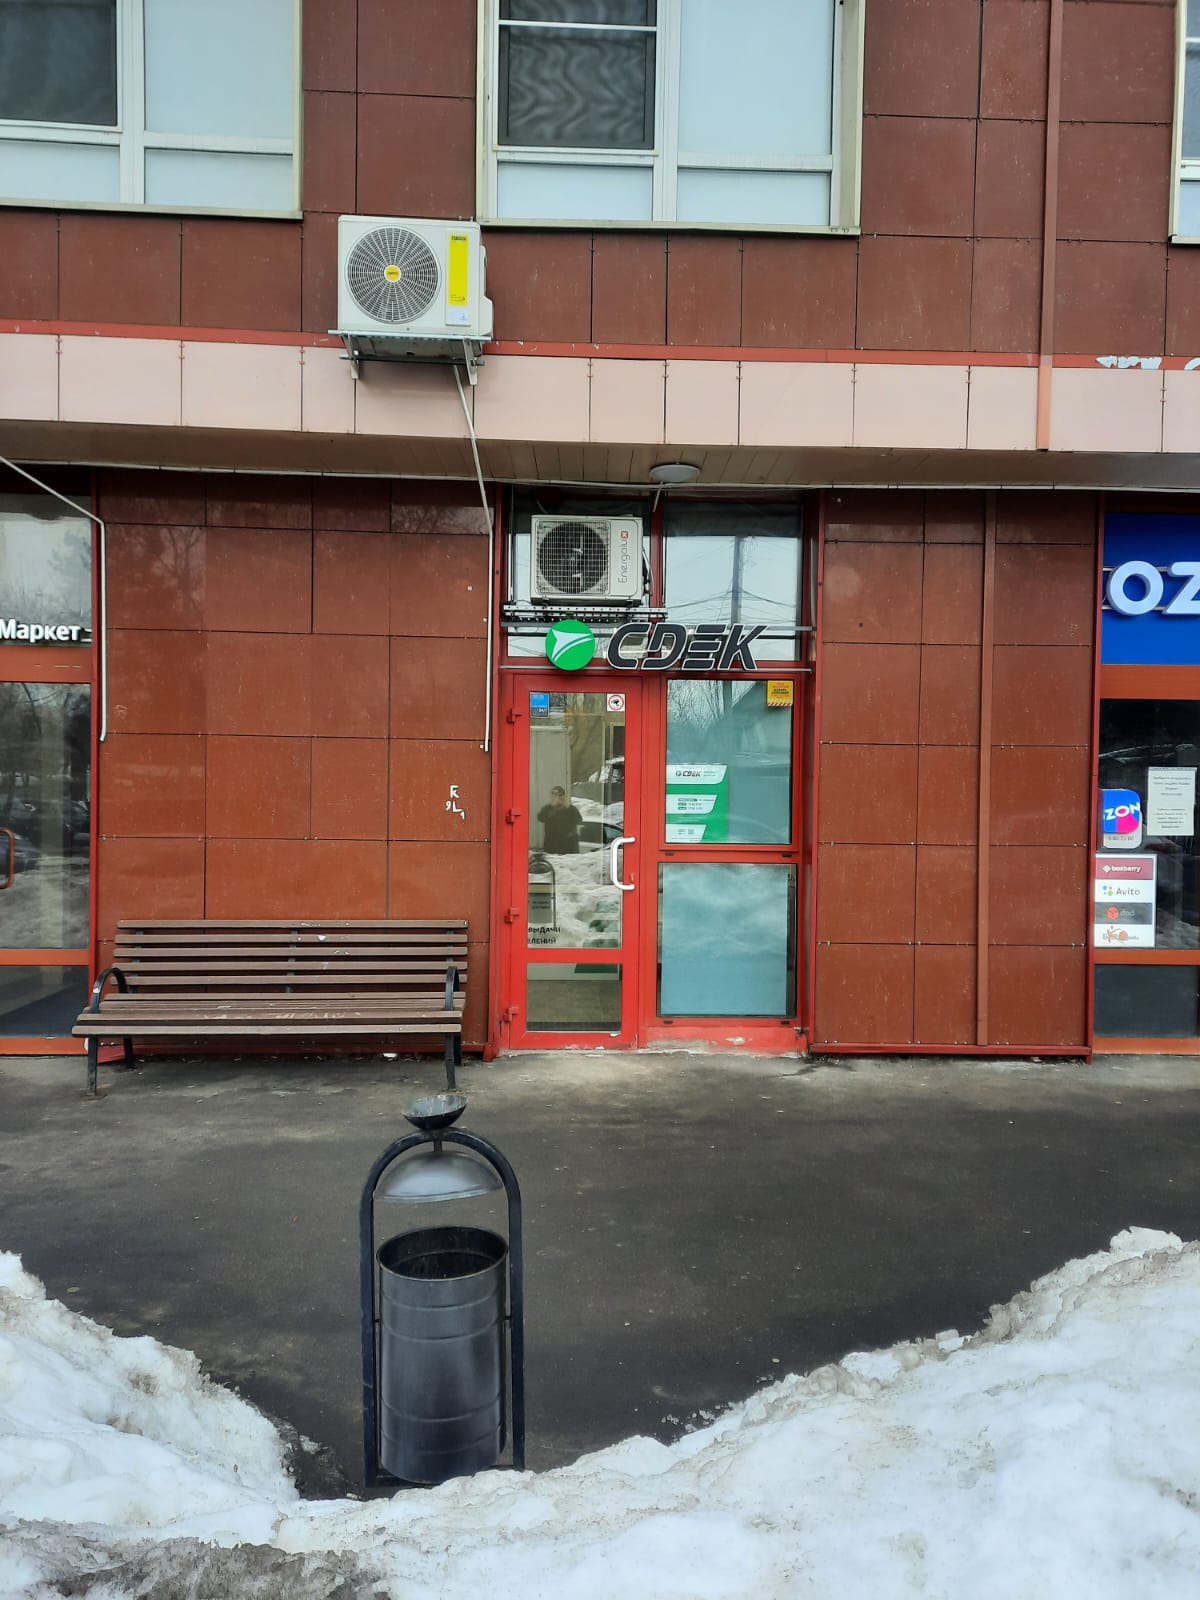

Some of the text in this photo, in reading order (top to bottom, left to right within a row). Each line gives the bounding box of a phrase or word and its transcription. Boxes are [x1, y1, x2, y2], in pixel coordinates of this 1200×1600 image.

[0, 618, 81, 643] Маркет
[606, 622, 768, 671] CDEK
[1104, 801, 1141, 820] ZON
[1115, 887, 1141, 896] Avito
